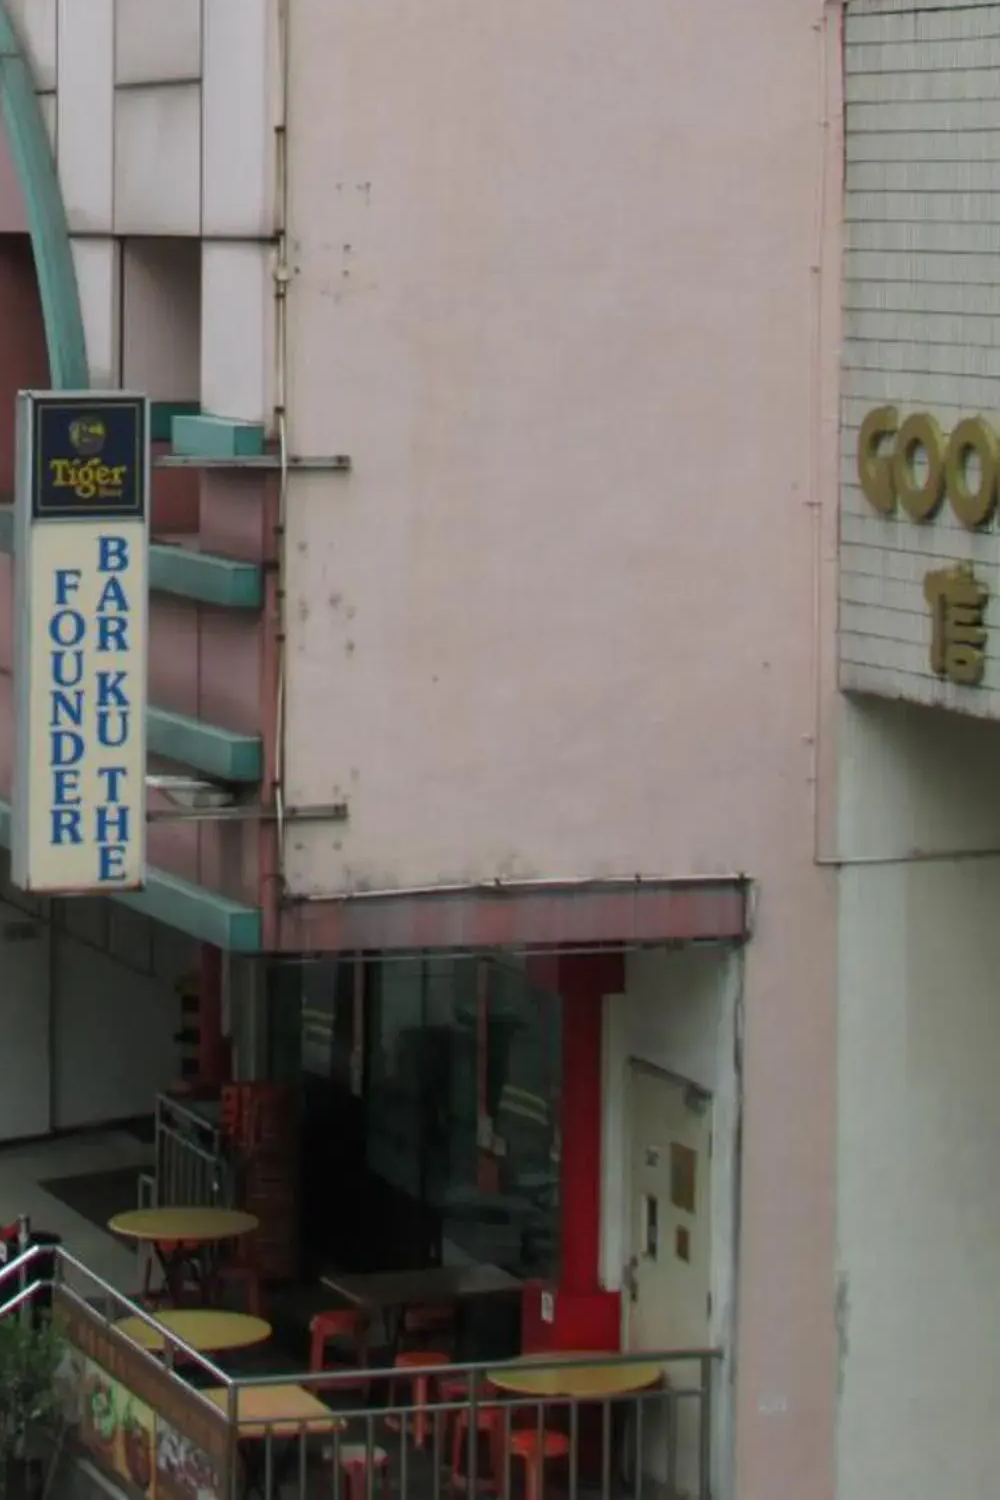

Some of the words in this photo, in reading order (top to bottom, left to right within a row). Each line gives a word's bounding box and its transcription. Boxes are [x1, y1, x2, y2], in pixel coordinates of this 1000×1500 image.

[49, 458, 127, 498] Tiger
[857, 405, 1000, 533] GOO
[48, 568, 86, 846] FOUNDER
